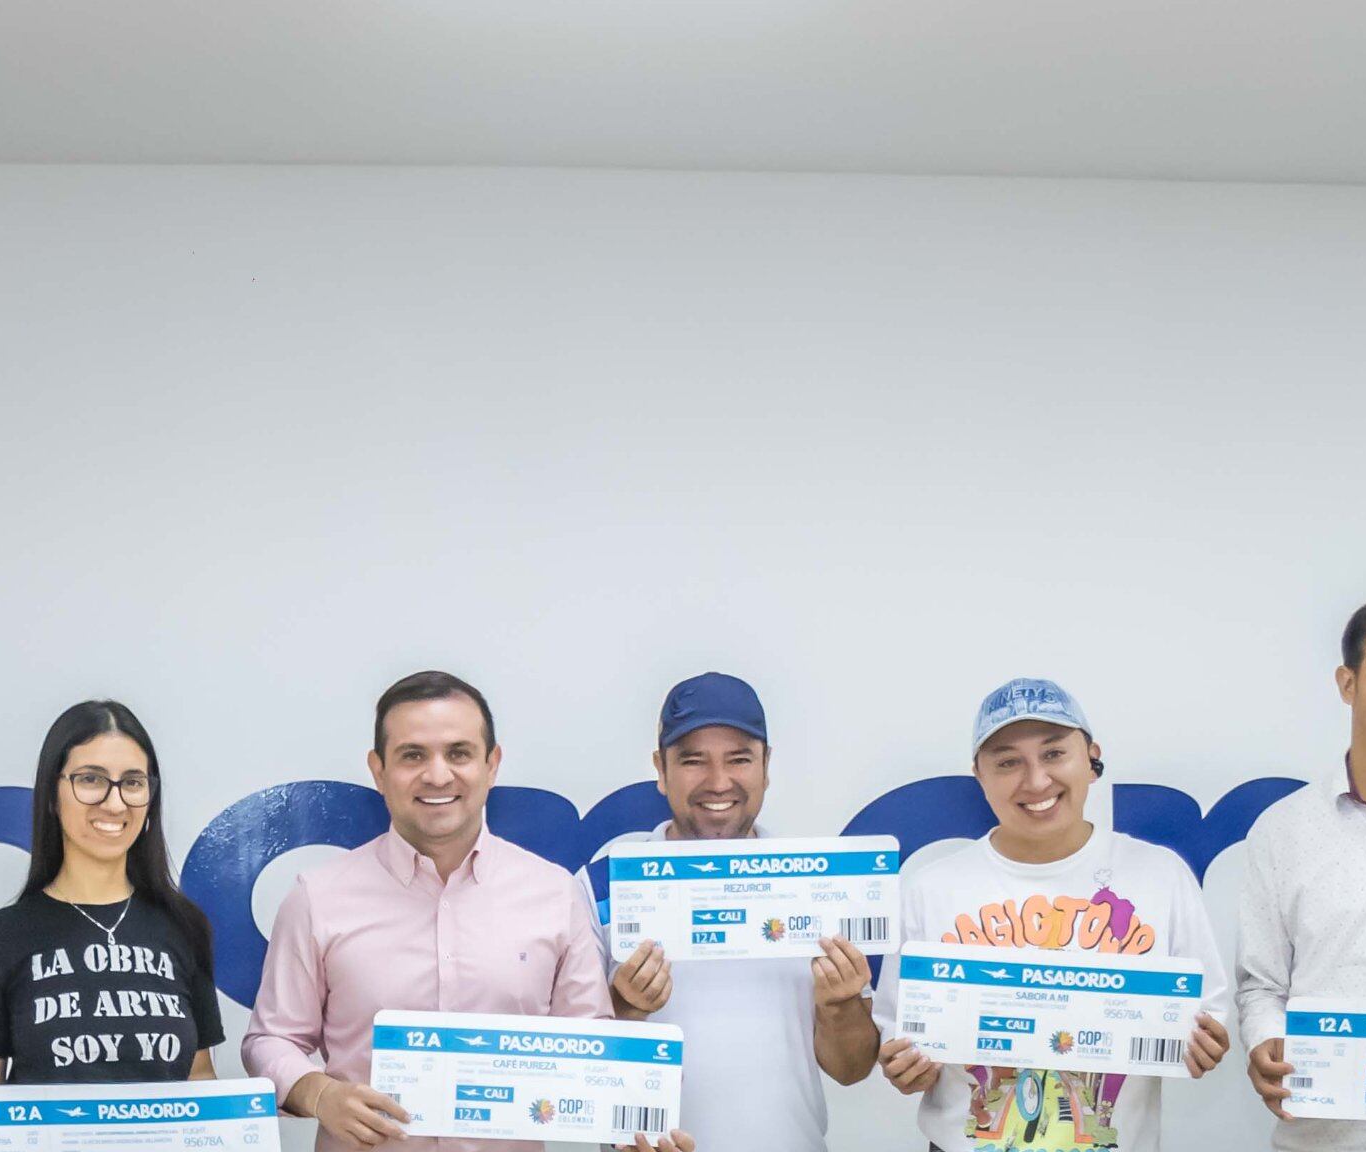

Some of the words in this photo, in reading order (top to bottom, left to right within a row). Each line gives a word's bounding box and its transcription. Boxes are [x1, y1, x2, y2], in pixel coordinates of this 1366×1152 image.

[642, 861, 659, 877] 12
[661, 861, 675, 876] A
[729, 857, 829, 875] PASABORDO
[724, 883, 771, 893] REZURCIR
[811, 891, 848, 901] 95678A
[718, 912, 741, 921] CALI
[788, 915, 822, 932] COP16
[31, 948, 74, 981] LA
[83, 944, 175, 980] OBRA
[932, 962, 950, 978] 12
[951, 964, 965, 979] A
[1022, 968, 1125, 989] PASABORDO
[1016, 992, 1047, 1001] SABOR
[1059, 994, 1069, 1002] MI
[34, 992, 82, 1024] DE
[93, 990, 185, 1019] ARTE
[1104, 1009, 1143, 1020] 95678A
[1006, 1020, 1029, 1030] CALI
[1318, 1017, 1337, 1032] 12
[1338, 1018, 1352, 1033] A
[406, 1031, 425, 1047] 12
[427, 1032, 441, 1047] A
[499, 1035, 605, 1056] PASABORDO
[1078, 1030, 1113, 1046] COP16
[51, 1034, 124, 1068] SOY
[135, 1033, 181, 1062] YO
[1077, 1047, 1112, 1055] COLOMBIA
[492, 1058, 517, 1069] CAFÉ
[519, 1060, 557, 1070] PUREZA
[584, 1075, 624, 1088] 95678A
[484, 1088, 508, 1099] CALI
[8, 1105, 26, 1121] 12
[29, 1105, 43, 1120] A
[97, 1101, 200, 1119] PASABORDO
[558, 1098, 595, 1115] COP16
[558, 1116, 594, 1124] COLOMBIA
[184, 1136, 224, 1147] 95678A
